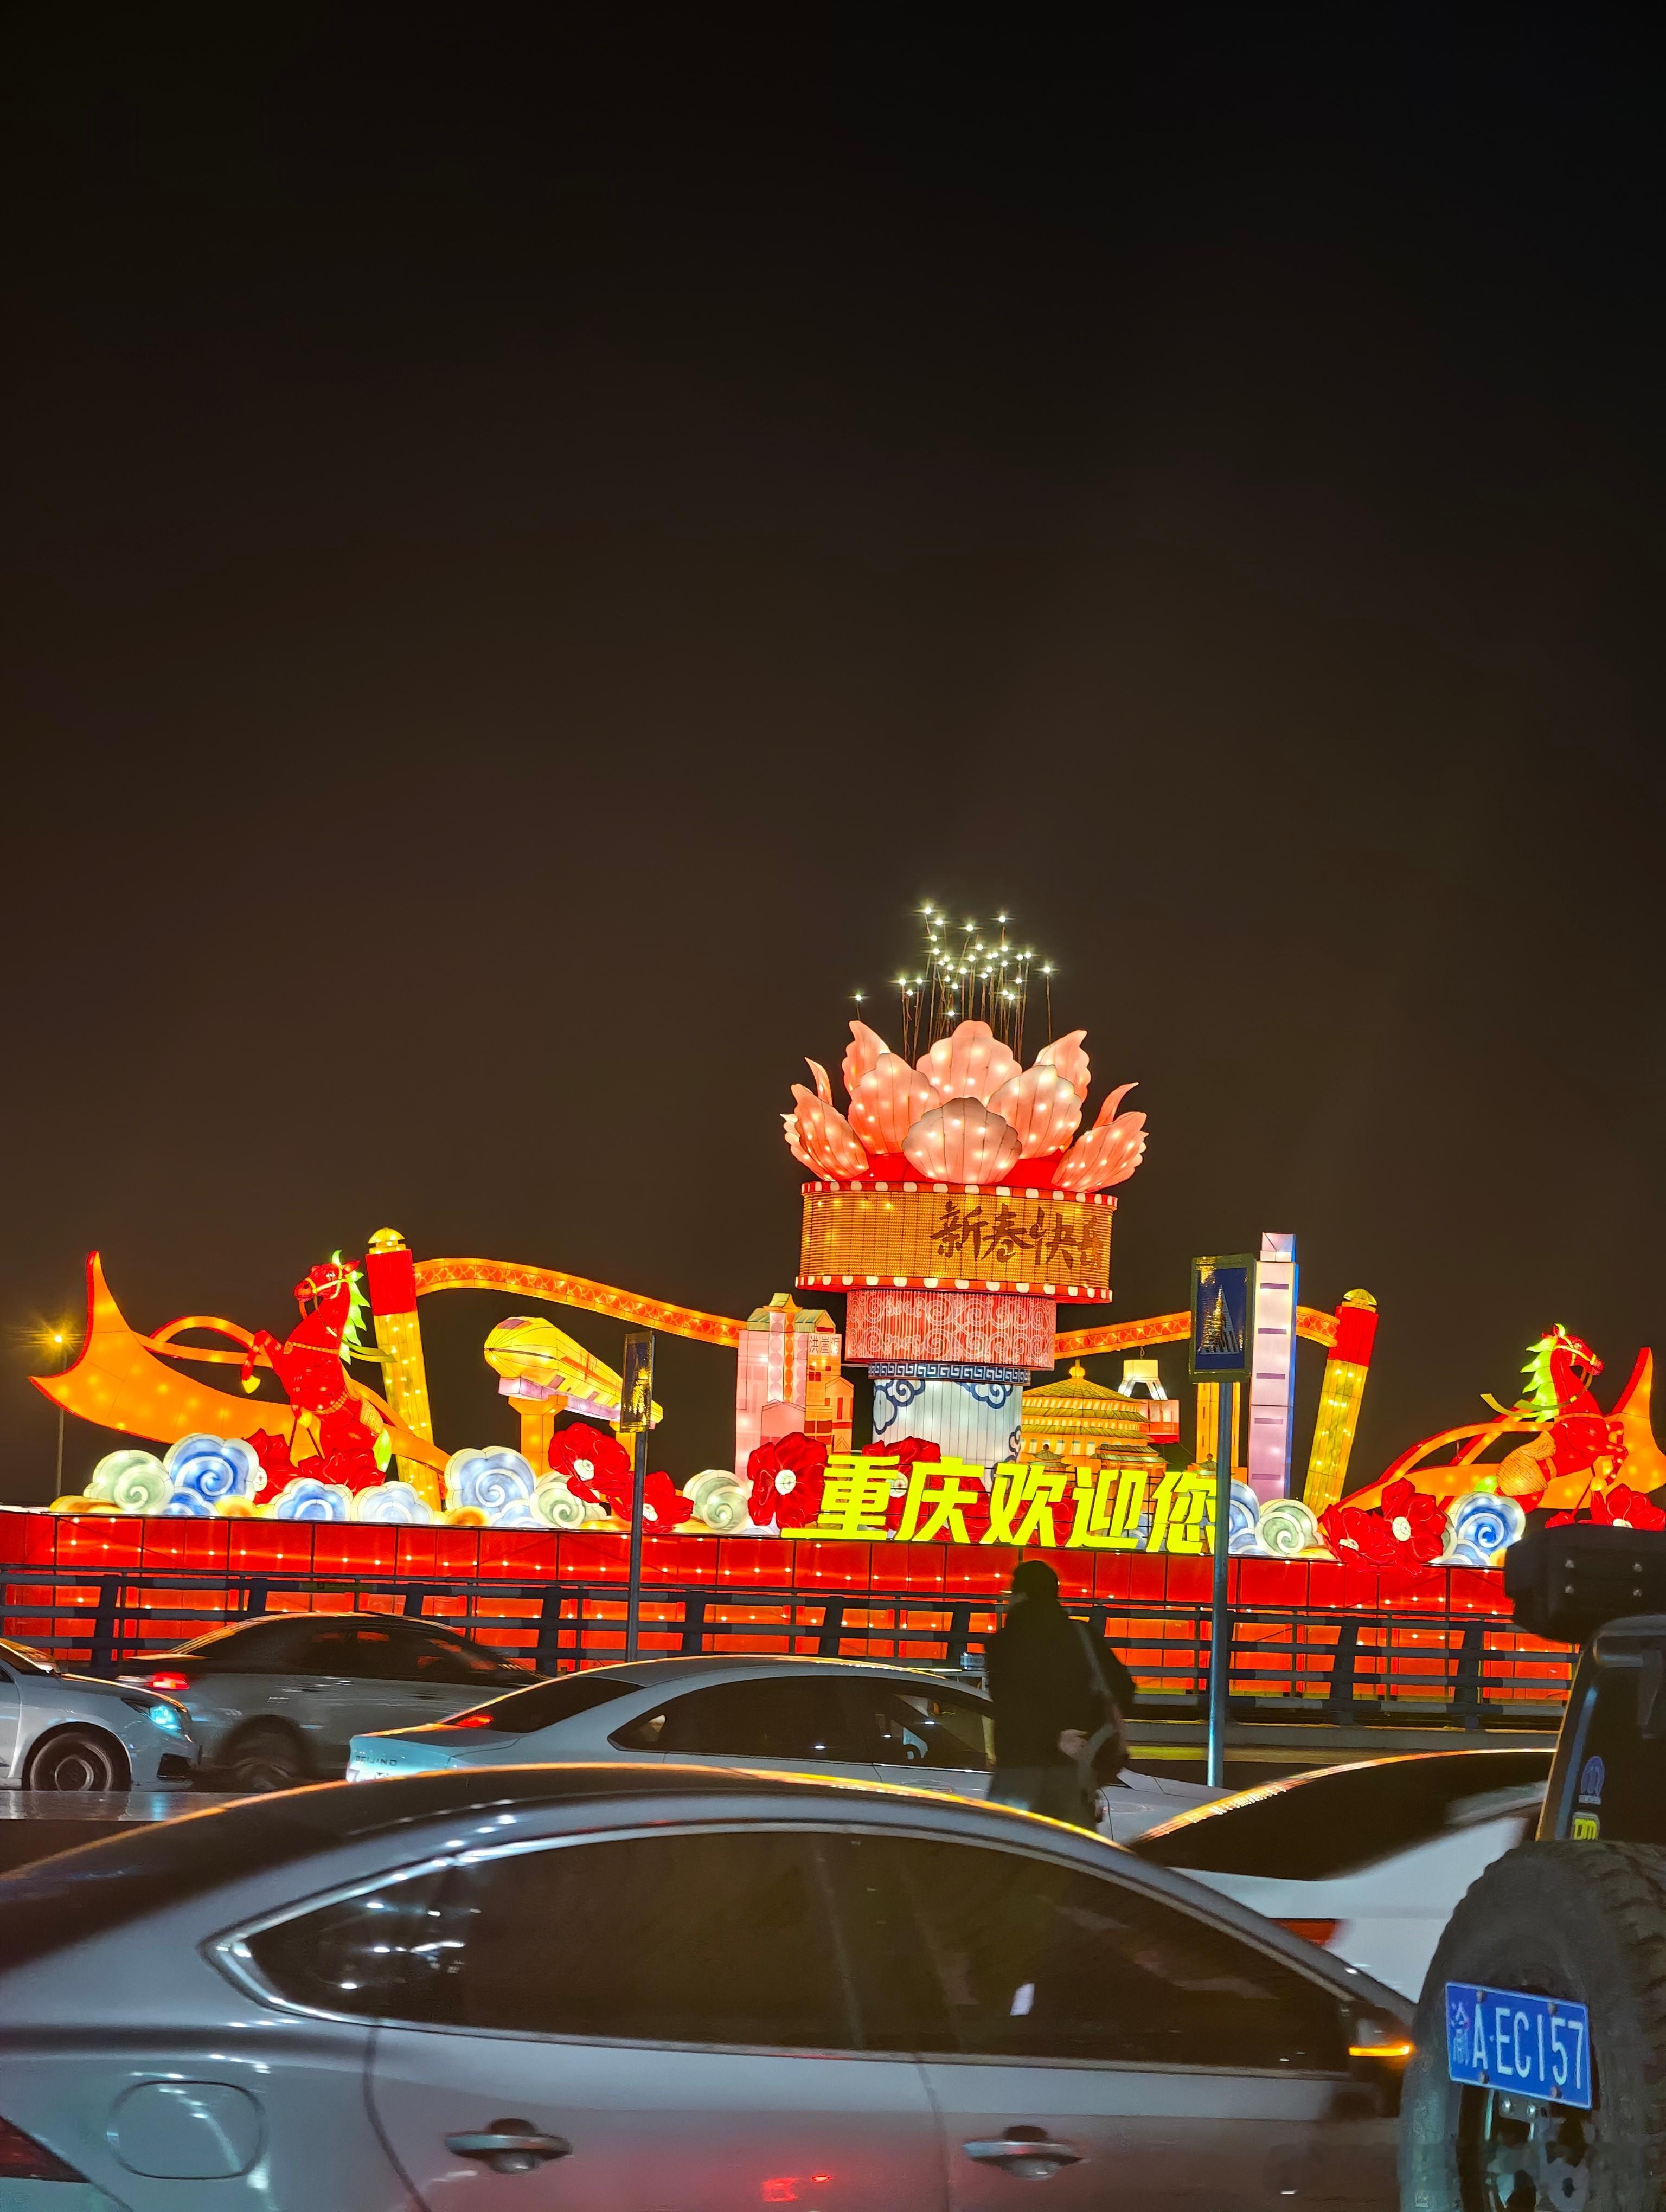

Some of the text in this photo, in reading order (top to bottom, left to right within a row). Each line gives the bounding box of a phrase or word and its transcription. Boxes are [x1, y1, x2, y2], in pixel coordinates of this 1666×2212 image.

[929, 1201, 1104, 1270] 新春快乐
[810, 1335, 840, 1355] 洪崖洞
[781, 1455, 1216, 1554] 重庆欢迎您
